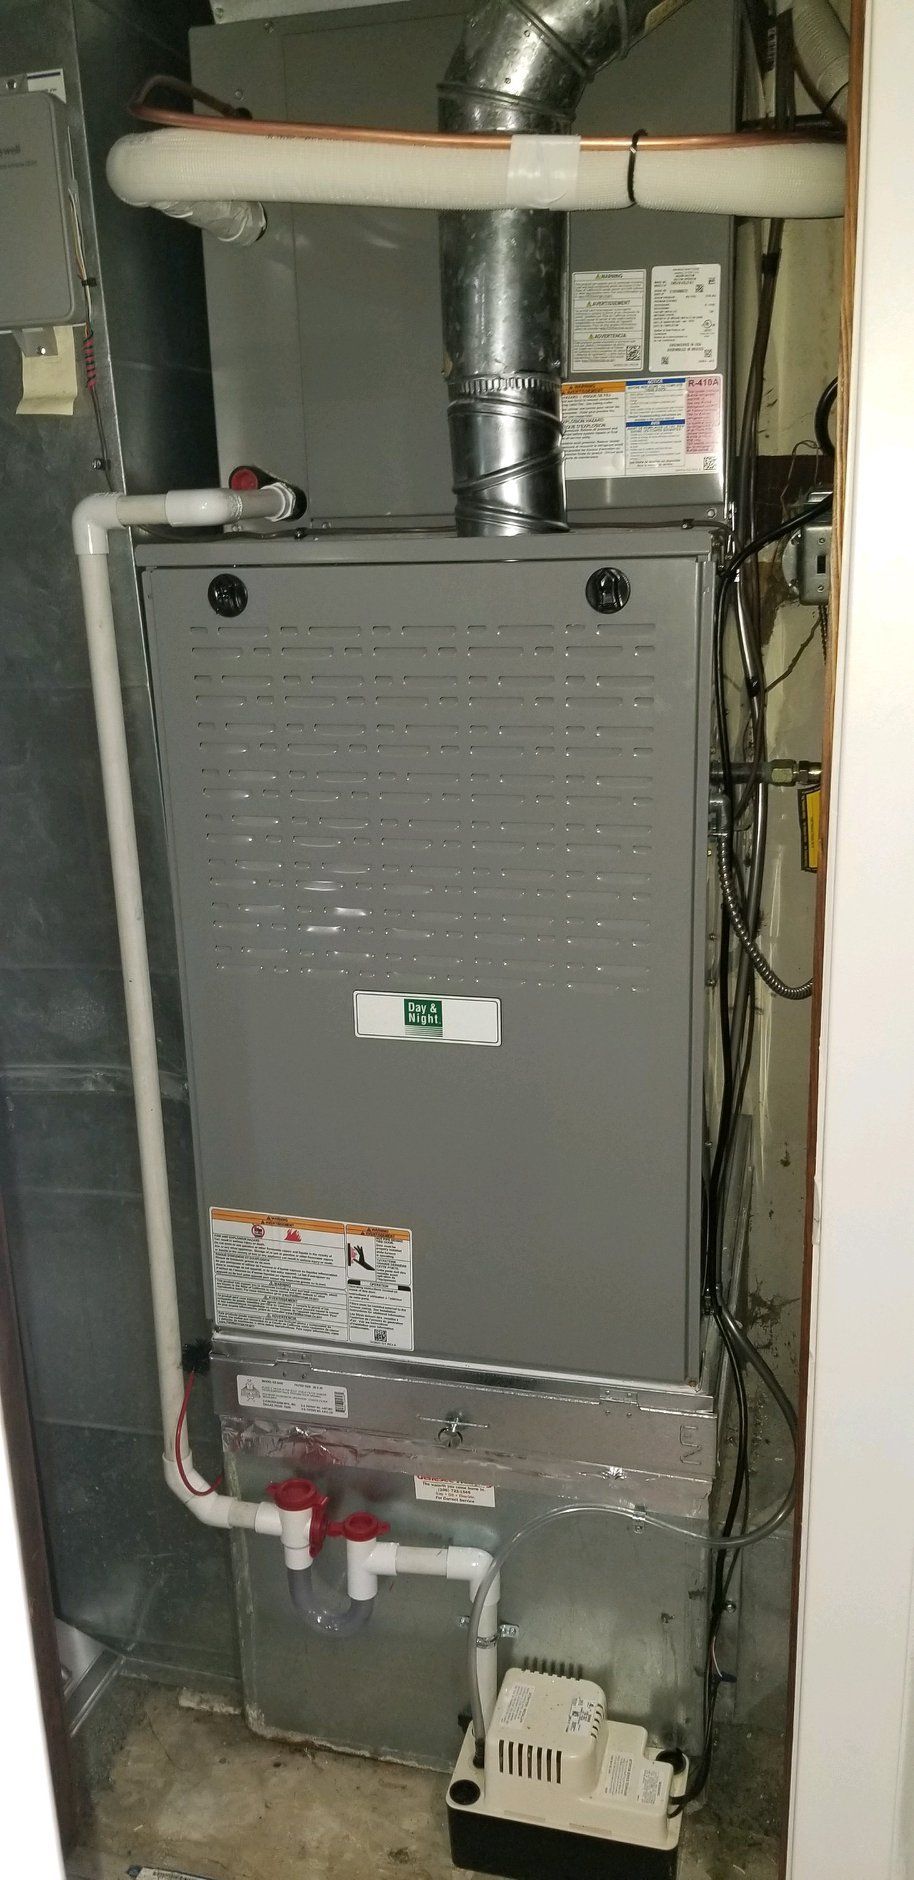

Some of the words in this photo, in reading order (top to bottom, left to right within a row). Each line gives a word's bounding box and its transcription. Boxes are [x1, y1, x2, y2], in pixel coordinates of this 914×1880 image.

[689, 379, 718, 387] R-410A
[408, 1002, 426, 1014] Day
[430, 1003, 437, 1013] &
[408, 1012, 438, 1025] Night
